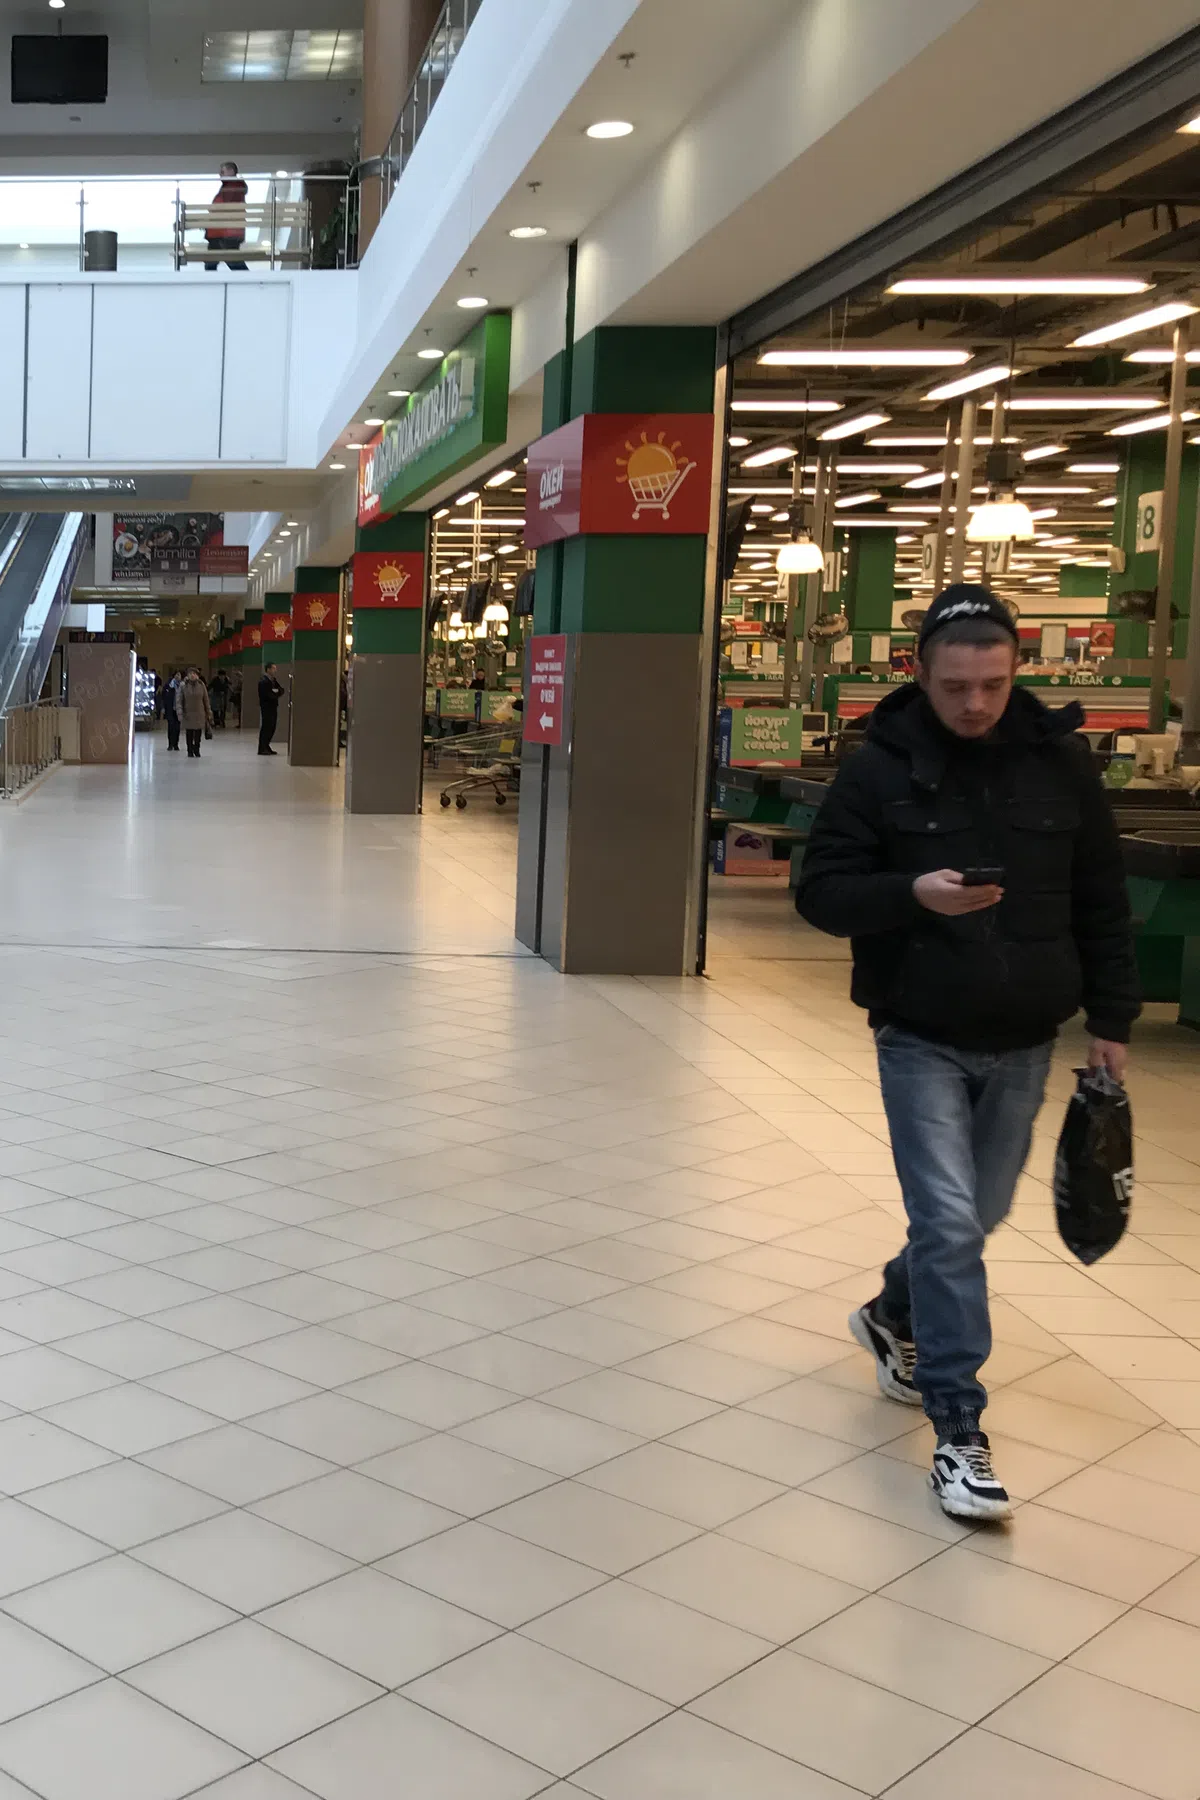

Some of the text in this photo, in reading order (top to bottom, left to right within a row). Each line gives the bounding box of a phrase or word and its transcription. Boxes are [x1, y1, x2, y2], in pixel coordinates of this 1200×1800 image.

[1142, 505, 1155, 540] 8
[886, 674, 915, 682] ТАБАК
[1068, 675, 1105, 686] ТАБАК
[744, 741, 789, 754] сахара
